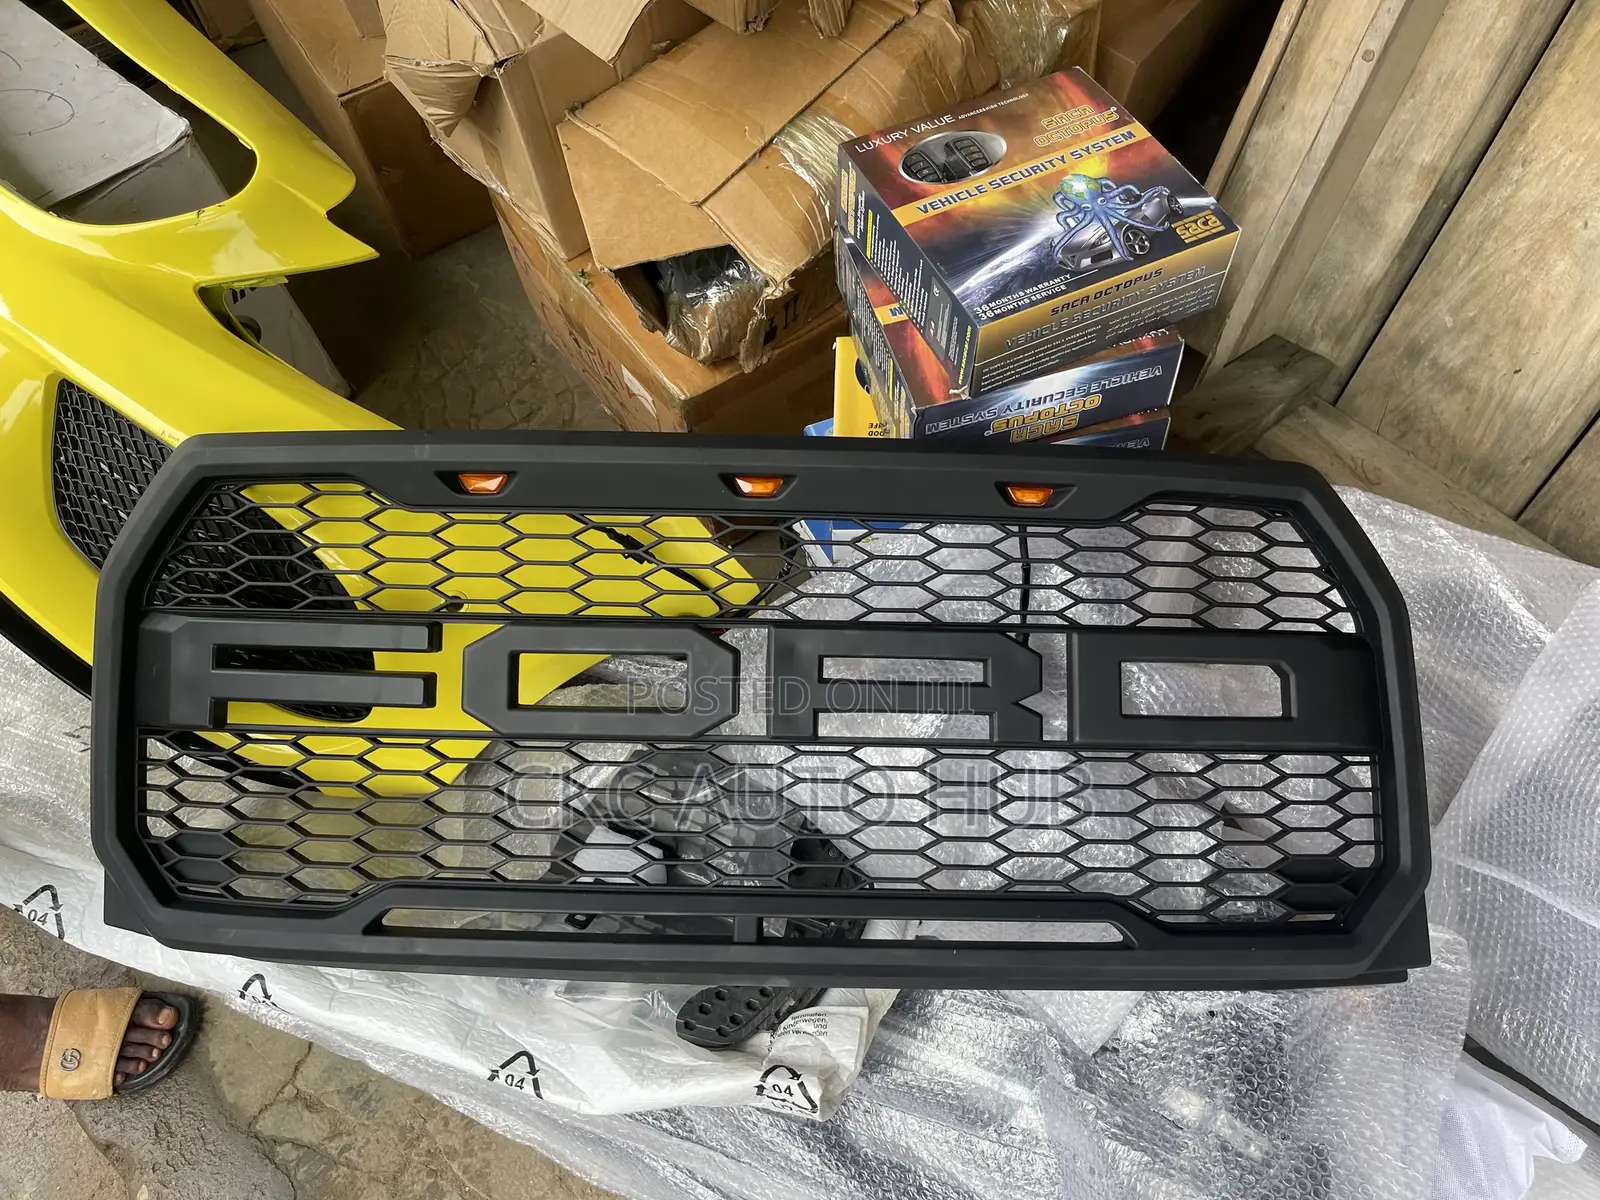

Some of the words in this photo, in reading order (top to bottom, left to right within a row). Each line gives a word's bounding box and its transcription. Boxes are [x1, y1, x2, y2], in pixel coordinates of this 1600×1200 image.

[1041, 105, 1095, 130] SACA
[854, 129, 909, 153] LUXURY
[910, 114, 956, 134] VALUE
[916, 184, 987, 214] VEHICLE
[988, 155, 1068, 190] SECURITY
[1070, 130, 1136, 160] SYSTEM
[1025, 274, 1071, 293] WARRANTY
[1031, 284, 1067, 301] SERVICE
[1051, 295, 1089, 316] SACA
[1094, 268, 1163, 300] OCTOPUS
[1005, 317, 1068, 349] VEHICLE
[1072, 288, 1144, 323] SECURITY
[1147, 266, 1206, 295] SYSTEM
[1090, 365, 1162, 392] VEHICLE
[1002, 384, 1088, 414] SECURITY
[925, 408, 998, 434] SYSTEM
[990, 394, 1103, 434] OCTOPUS
[1010, 413, 1080, 443] SACA
[138, 615, 1380, 750] FORD
[28, 909, 48, 925] 04
[504, 1073, 525, 1090] 04
[772, 1083, 794, 1097] 04
